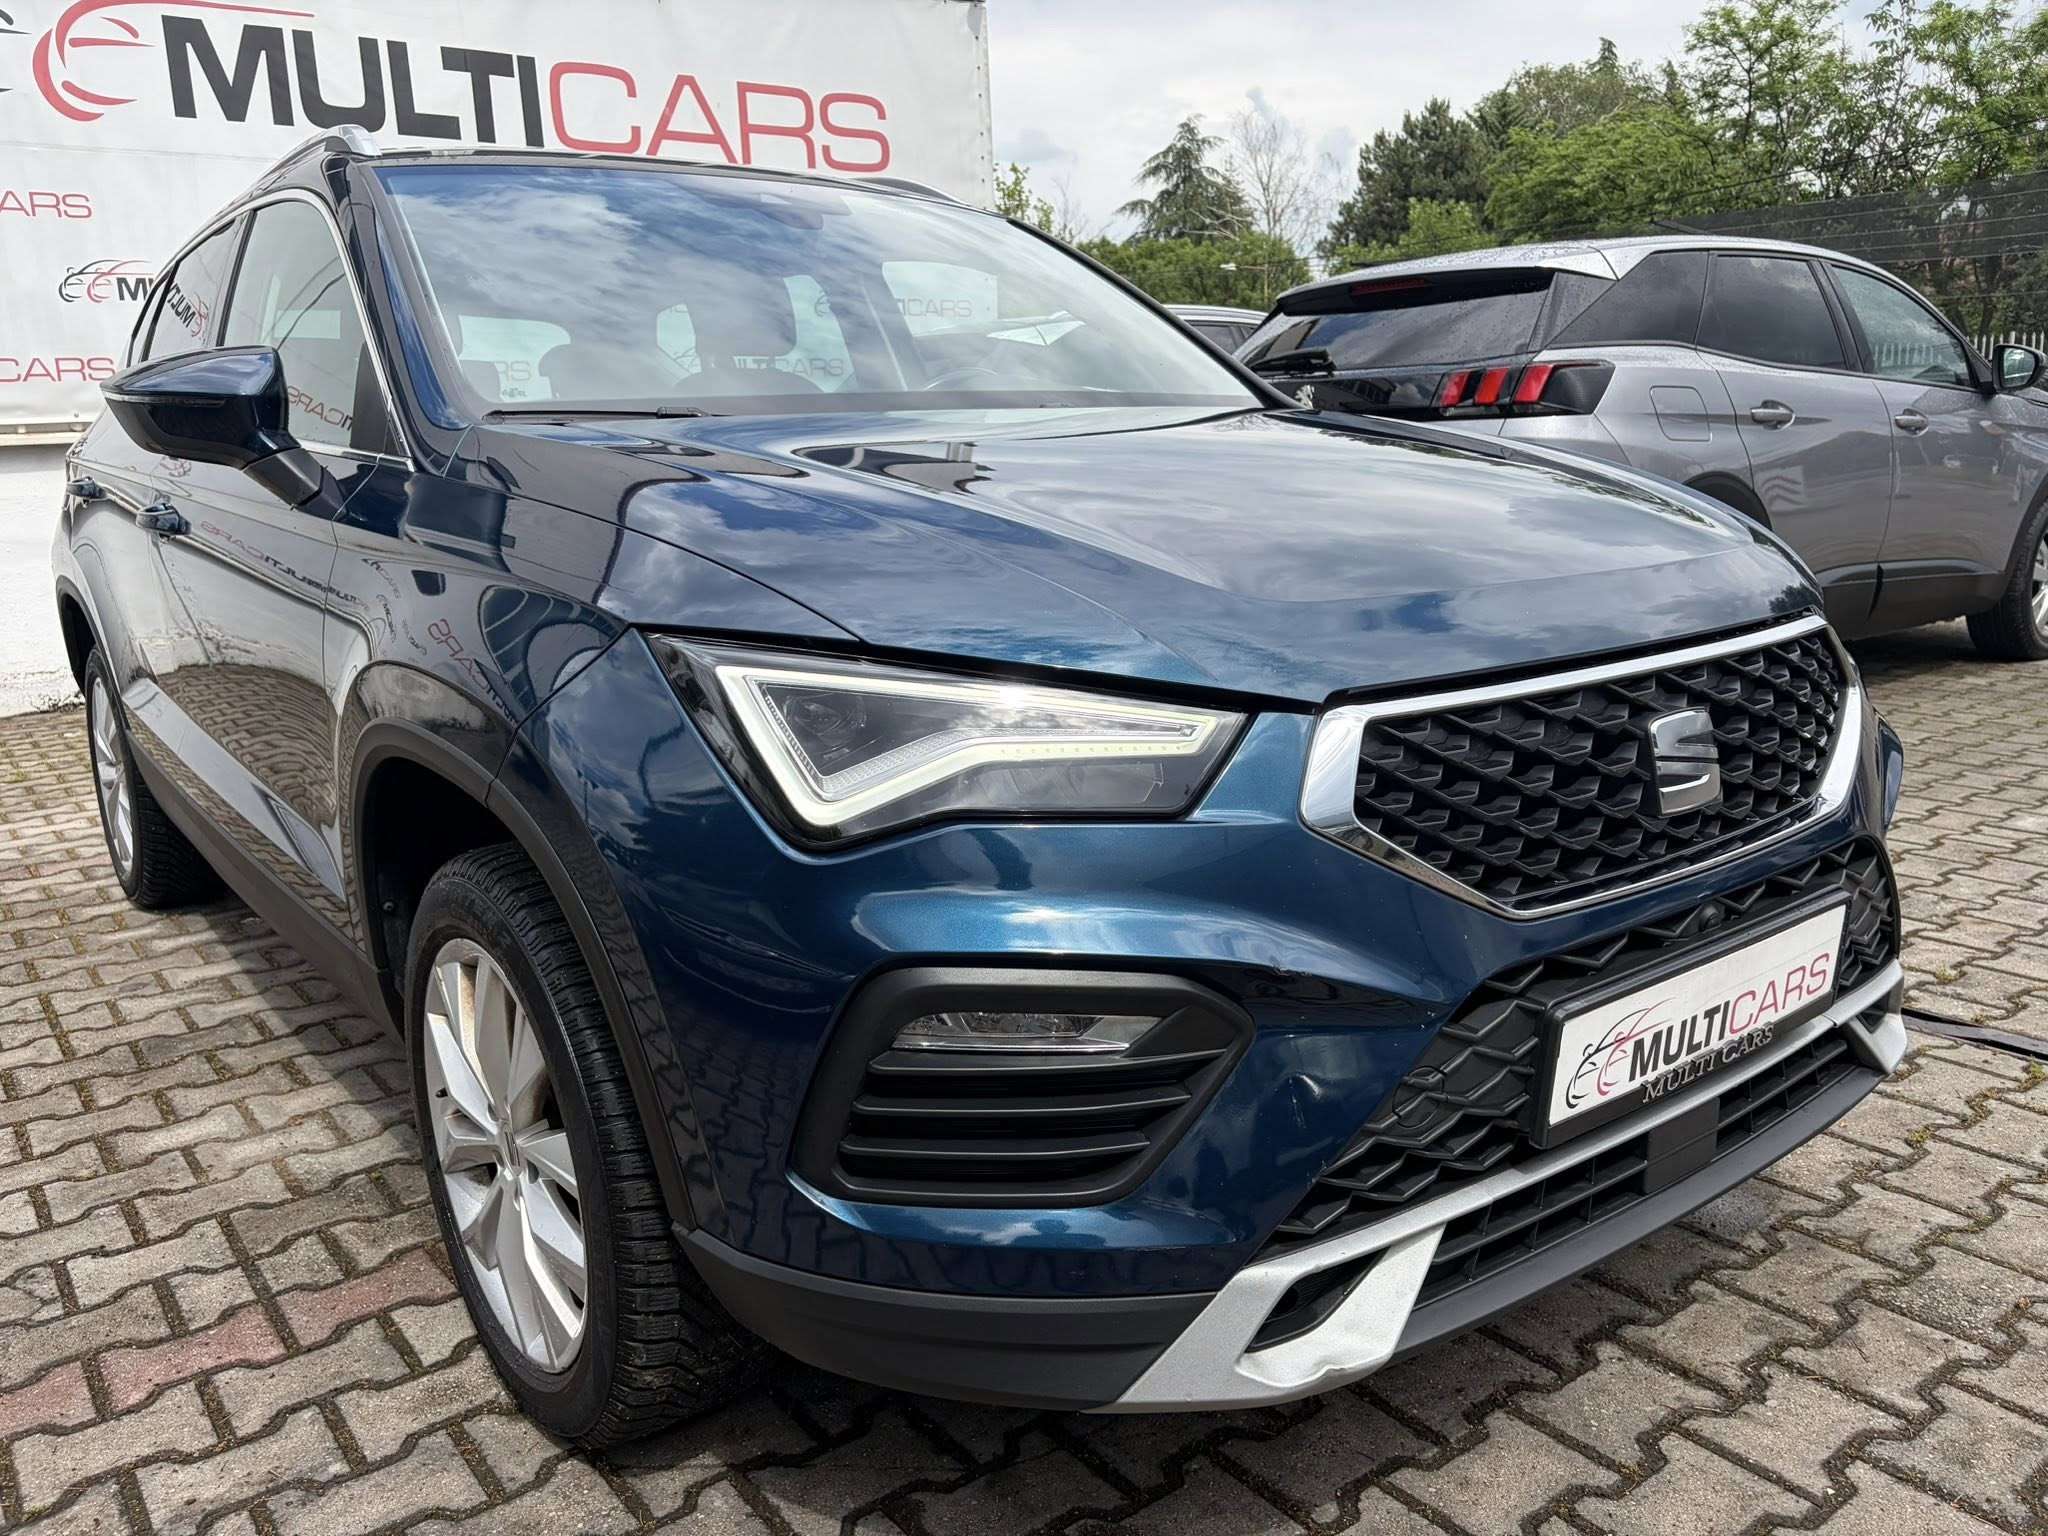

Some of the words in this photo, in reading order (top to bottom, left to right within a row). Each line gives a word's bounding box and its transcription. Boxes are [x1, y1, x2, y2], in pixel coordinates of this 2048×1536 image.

[161, 14, 891, 173] MULTICARS
[1628, 952, 1830, 1082] MULTICARS
[1641, 1052, 1717, 1103] MULTI
[1721, 1021, 1775, 1064] CARS
